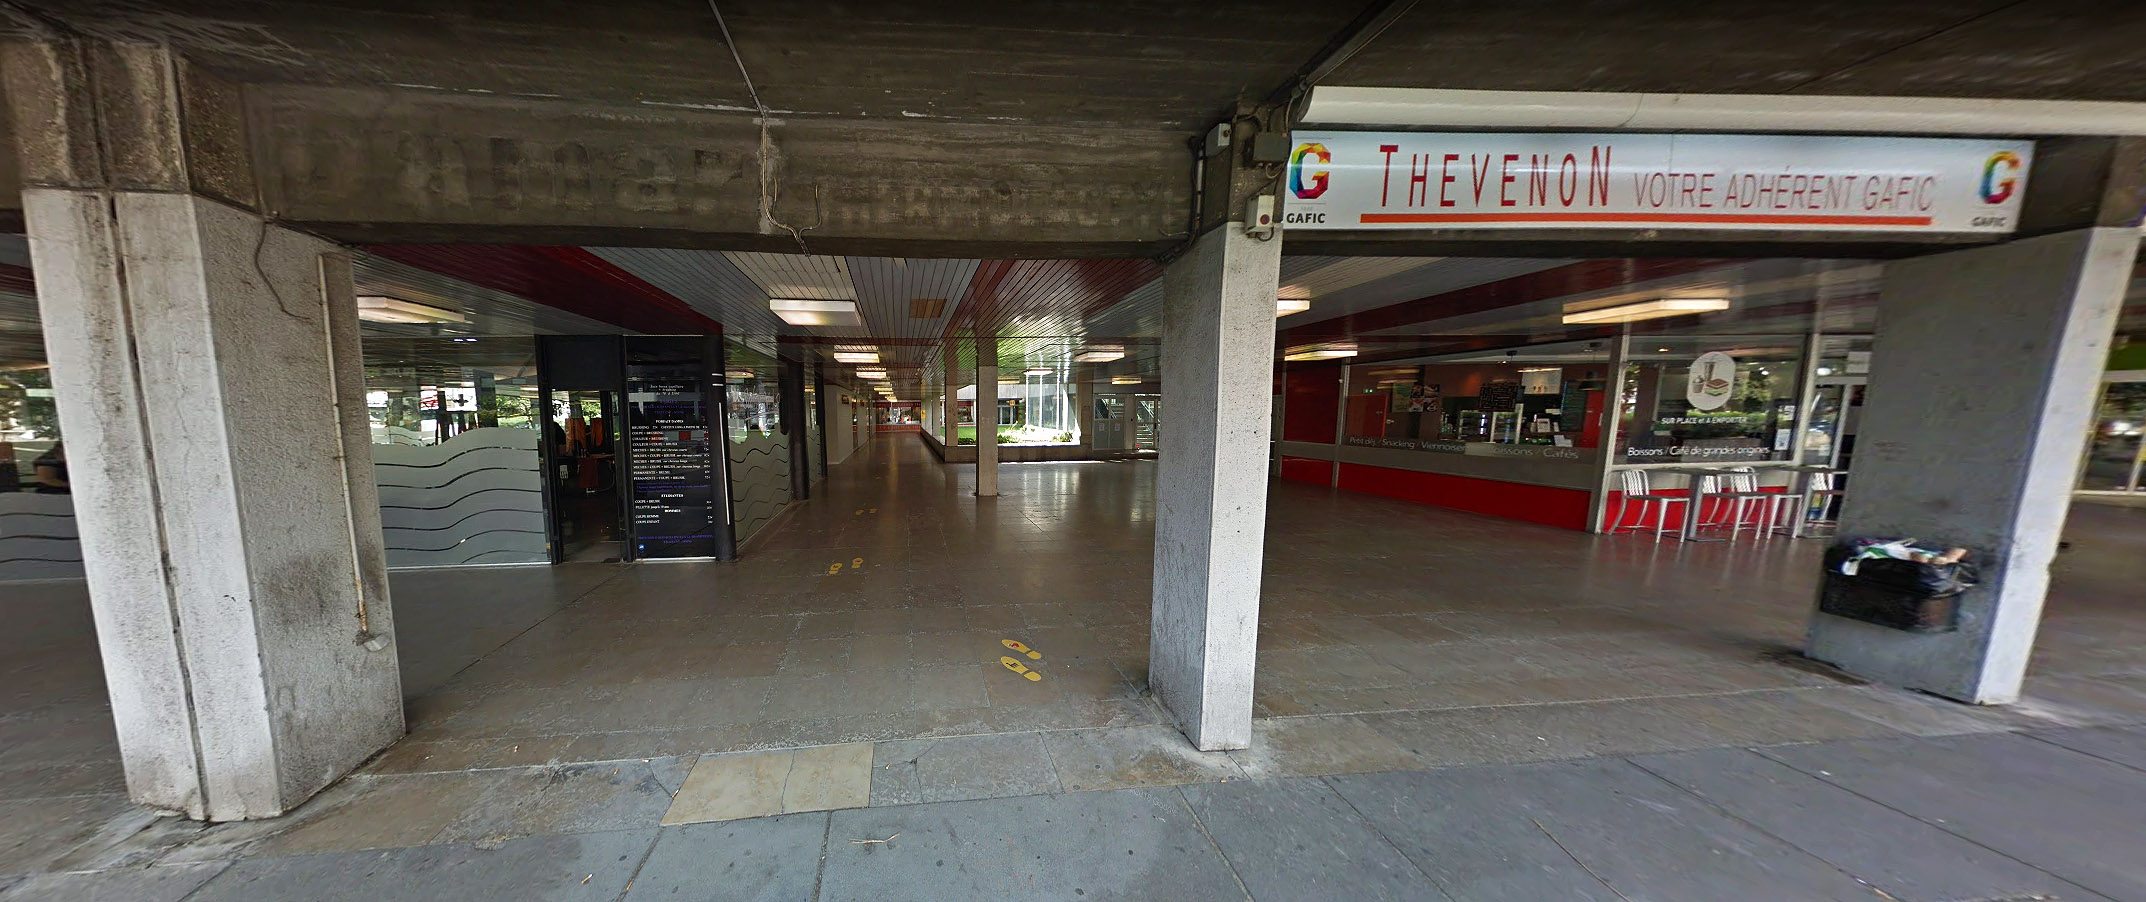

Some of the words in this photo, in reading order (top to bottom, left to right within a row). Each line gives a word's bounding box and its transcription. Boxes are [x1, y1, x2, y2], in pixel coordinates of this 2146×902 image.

[1379, 144, 1612, 207] THEVENON
[1632, 172, 1716, 208] VOTRE
[1722, 164, 1860, 210] ADHÉRENT
[1862, 174, 1936, 212] GAFIC
[1286, 212, 1326, 224] GAFIC
[1661, 417, 1676, 425] SUR
[1676, 417, 1697, 425] PLACE
[1711, 416, 1748, 425] EMPORTER
[1349, 436, 1364, 445] Petit
[1382, 438, 1415, 450] Snacking
[1543, 447, 1580, 459] Cafés
[1627, 446, 1663, 457] Boissons
[1669, 445, 1690, 456] Café
[1690, 446, 1702, 455] de
[1702, 446, 1737, 458] grandes
[1737, 445, 1771, 457] origines
